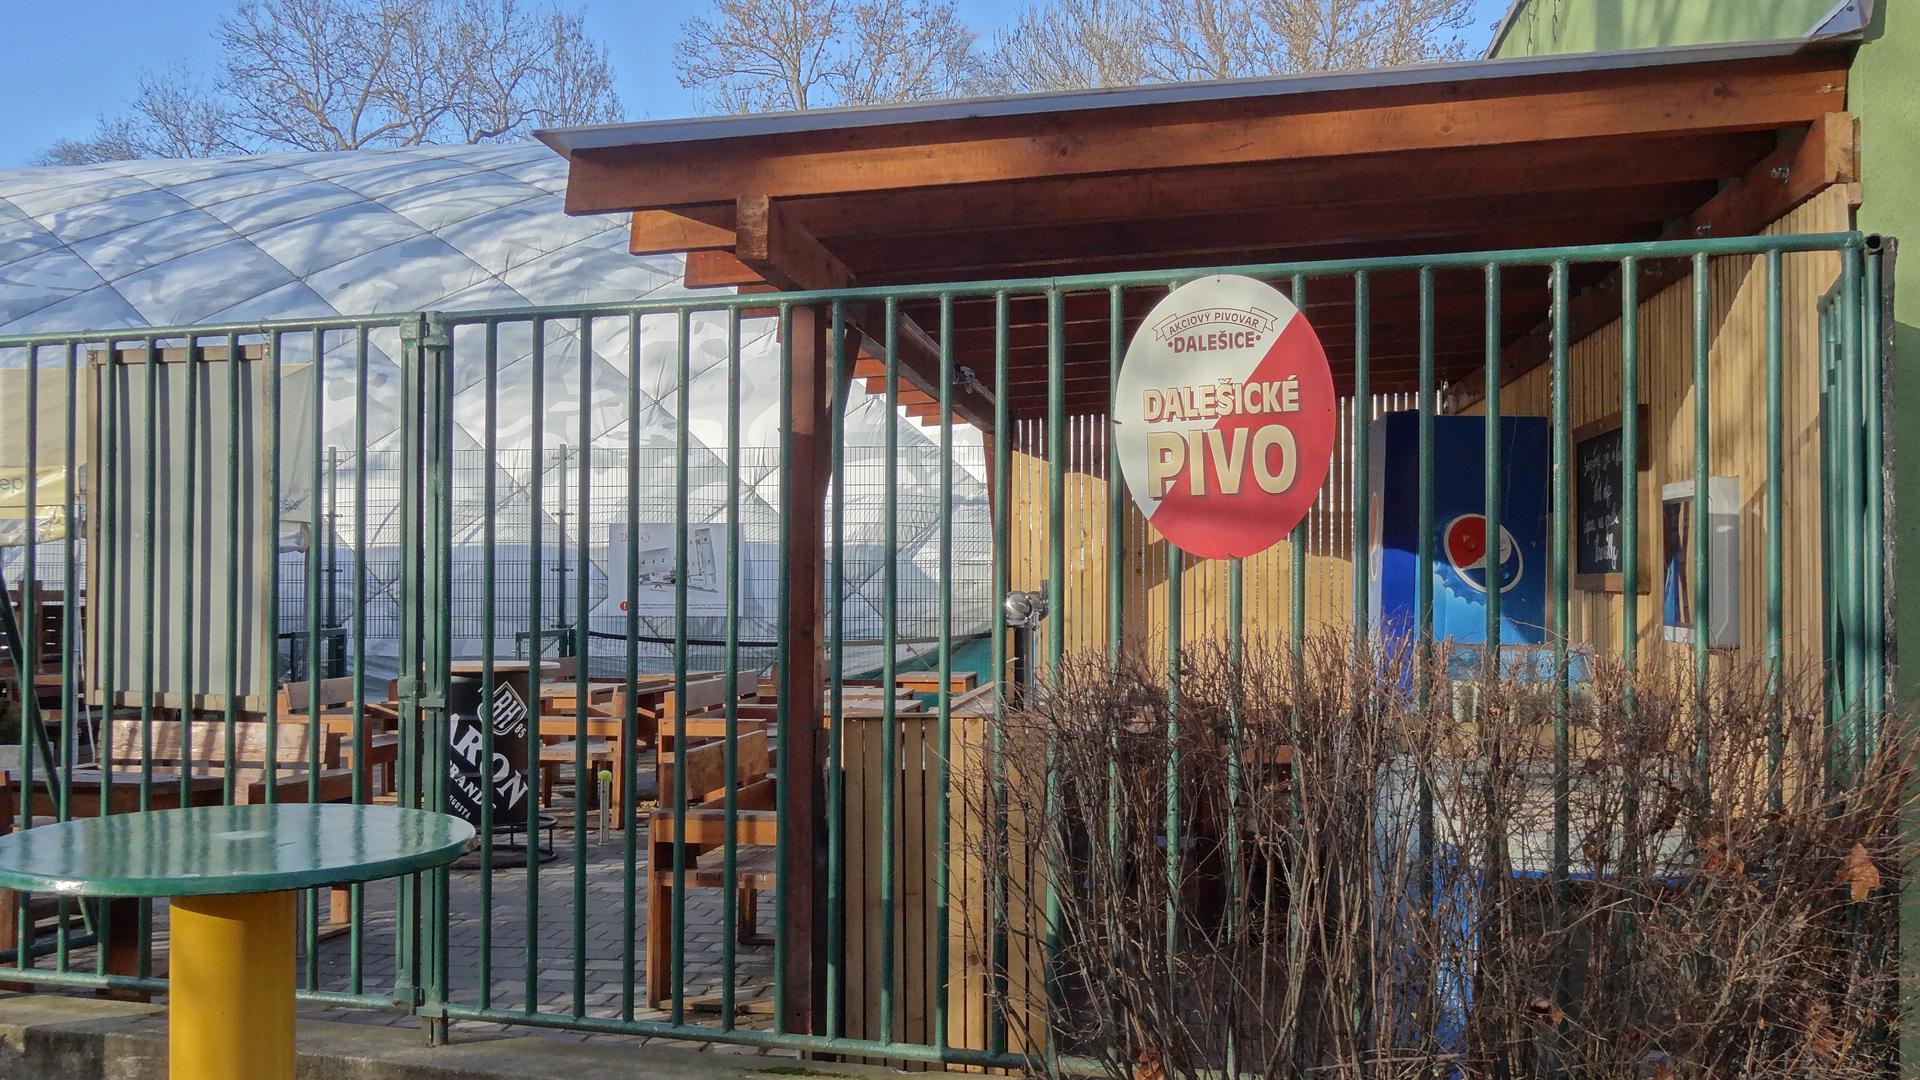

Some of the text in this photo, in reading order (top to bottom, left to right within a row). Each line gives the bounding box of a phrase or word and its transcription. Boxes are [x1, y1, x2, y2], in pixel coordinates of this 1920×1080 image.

[1168, 311, 1260, 335] AKCIOVÝ PIVOVAR
[1143, 374, 1300, 424] DALEŠICKÉ
[1146, 424, 1298, 501] PIVO
